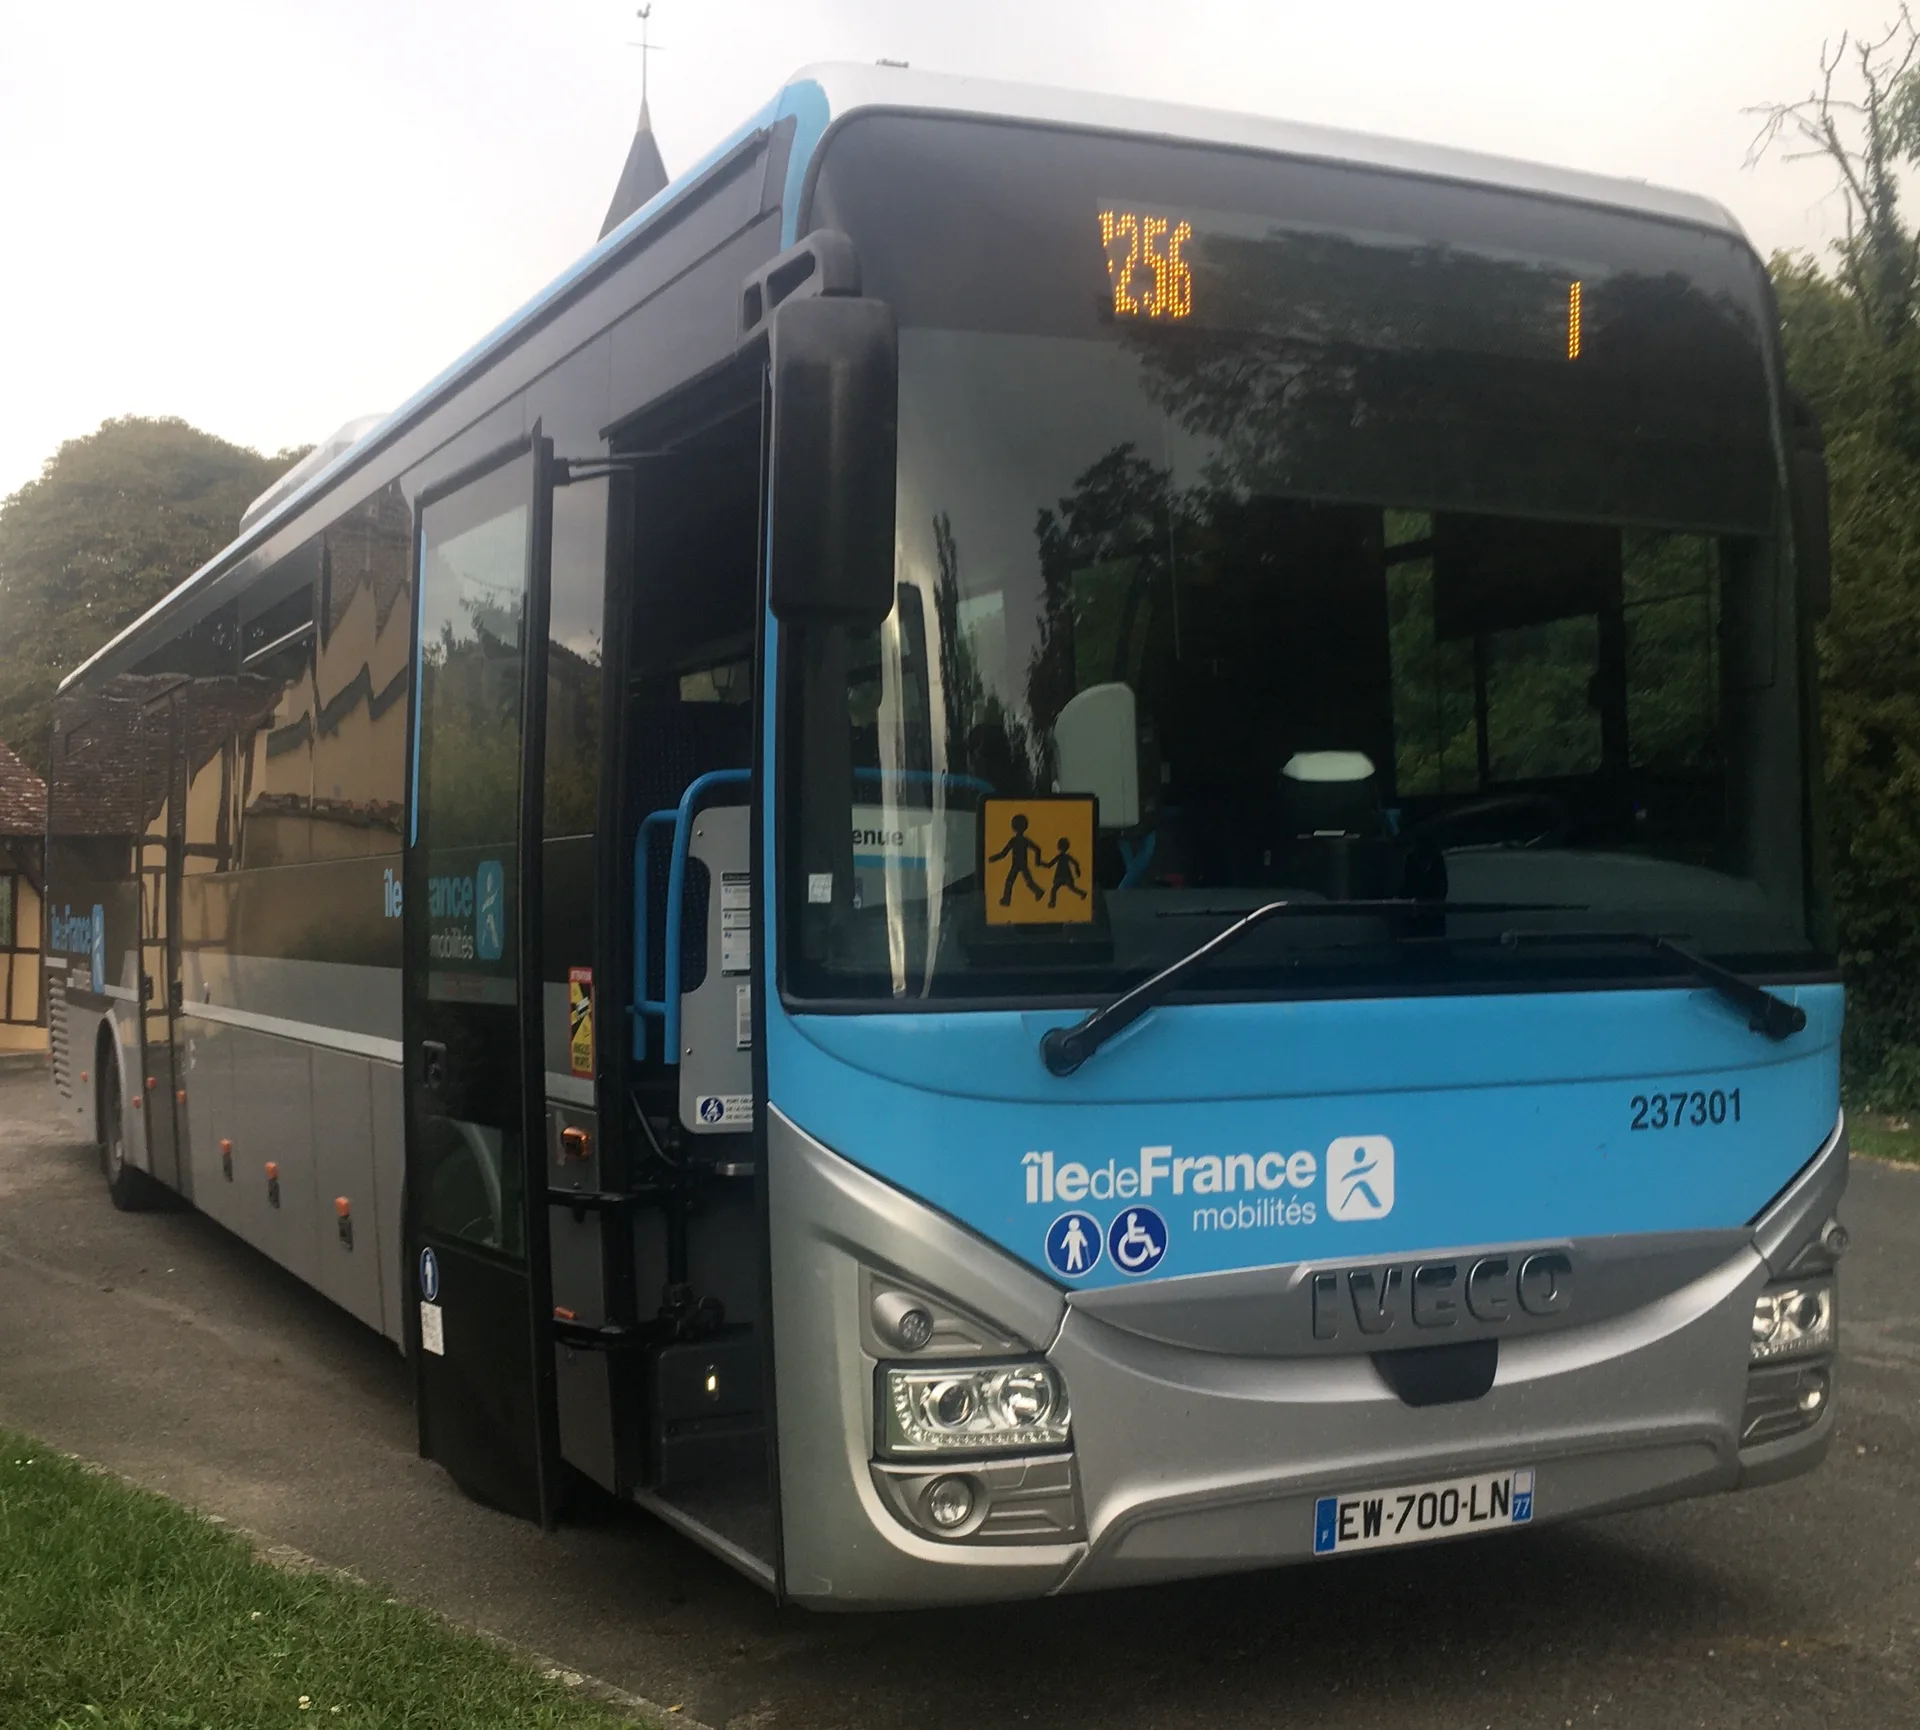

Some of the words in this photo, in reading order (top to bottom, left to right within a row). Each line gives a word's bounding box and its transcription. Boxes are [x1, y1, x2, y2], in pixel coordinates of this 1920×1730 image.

[852, 828, 904, 846] enue
[1630, 1088, 1741, 1131] 237301
[1193, 1194, 1317, 1233] mobilités
[1312, 1251, 1574, 1340] IVECO
[1338, 1479, 1511, 1542] EW-700-LN
[1513, 1498, 1530, 1518] 77
